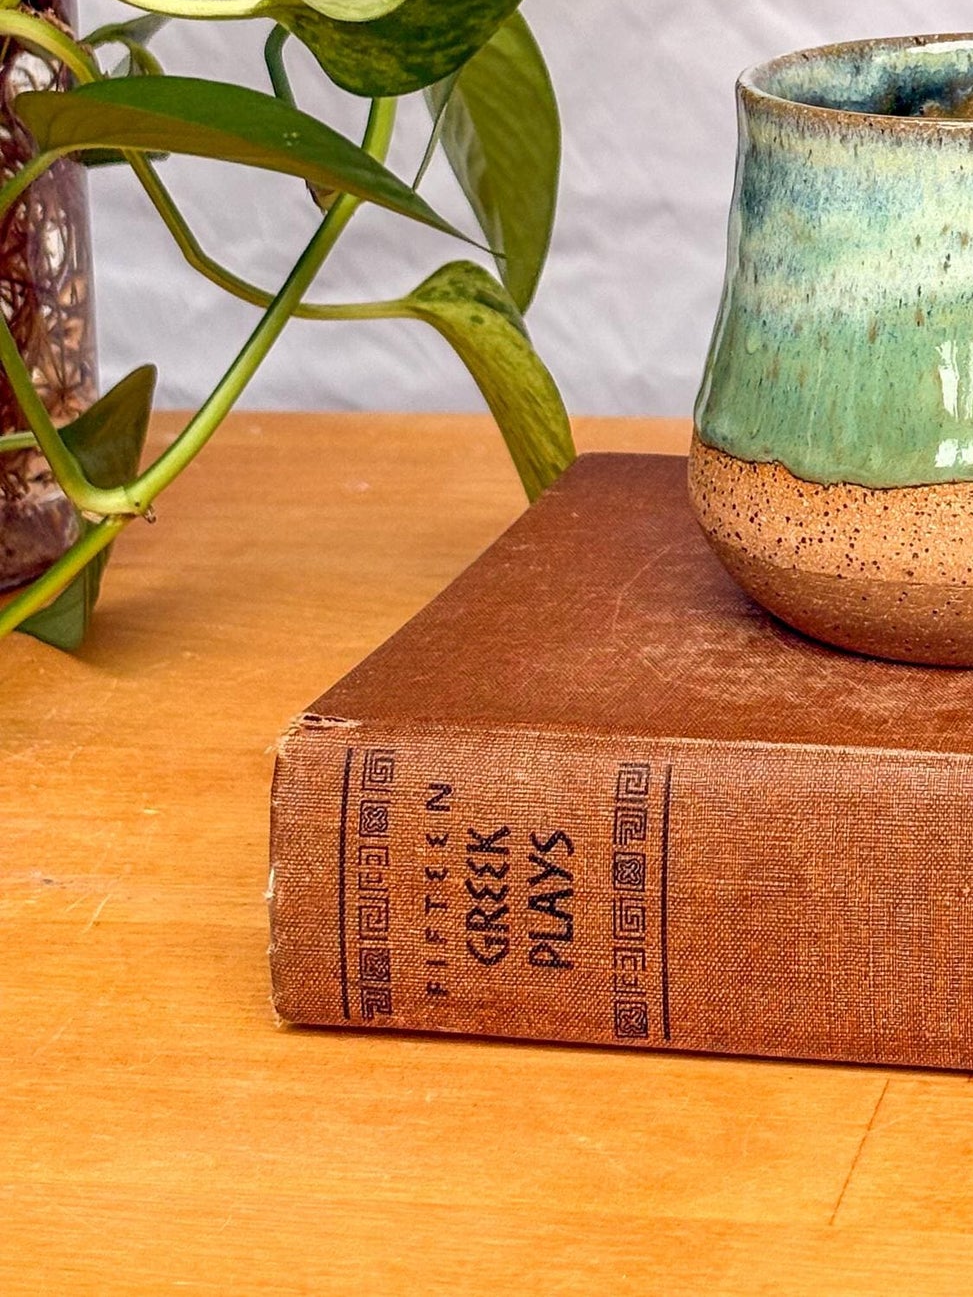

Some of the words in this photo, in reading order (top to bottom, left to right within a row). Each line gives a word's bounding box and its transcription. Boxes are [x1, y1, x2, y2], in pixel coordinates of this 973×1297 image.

[424, 782, 453, 997] FIFTEEN
[465, 825, 511, 966] GREEK
[528, 830, 574, 970] PLAYS
